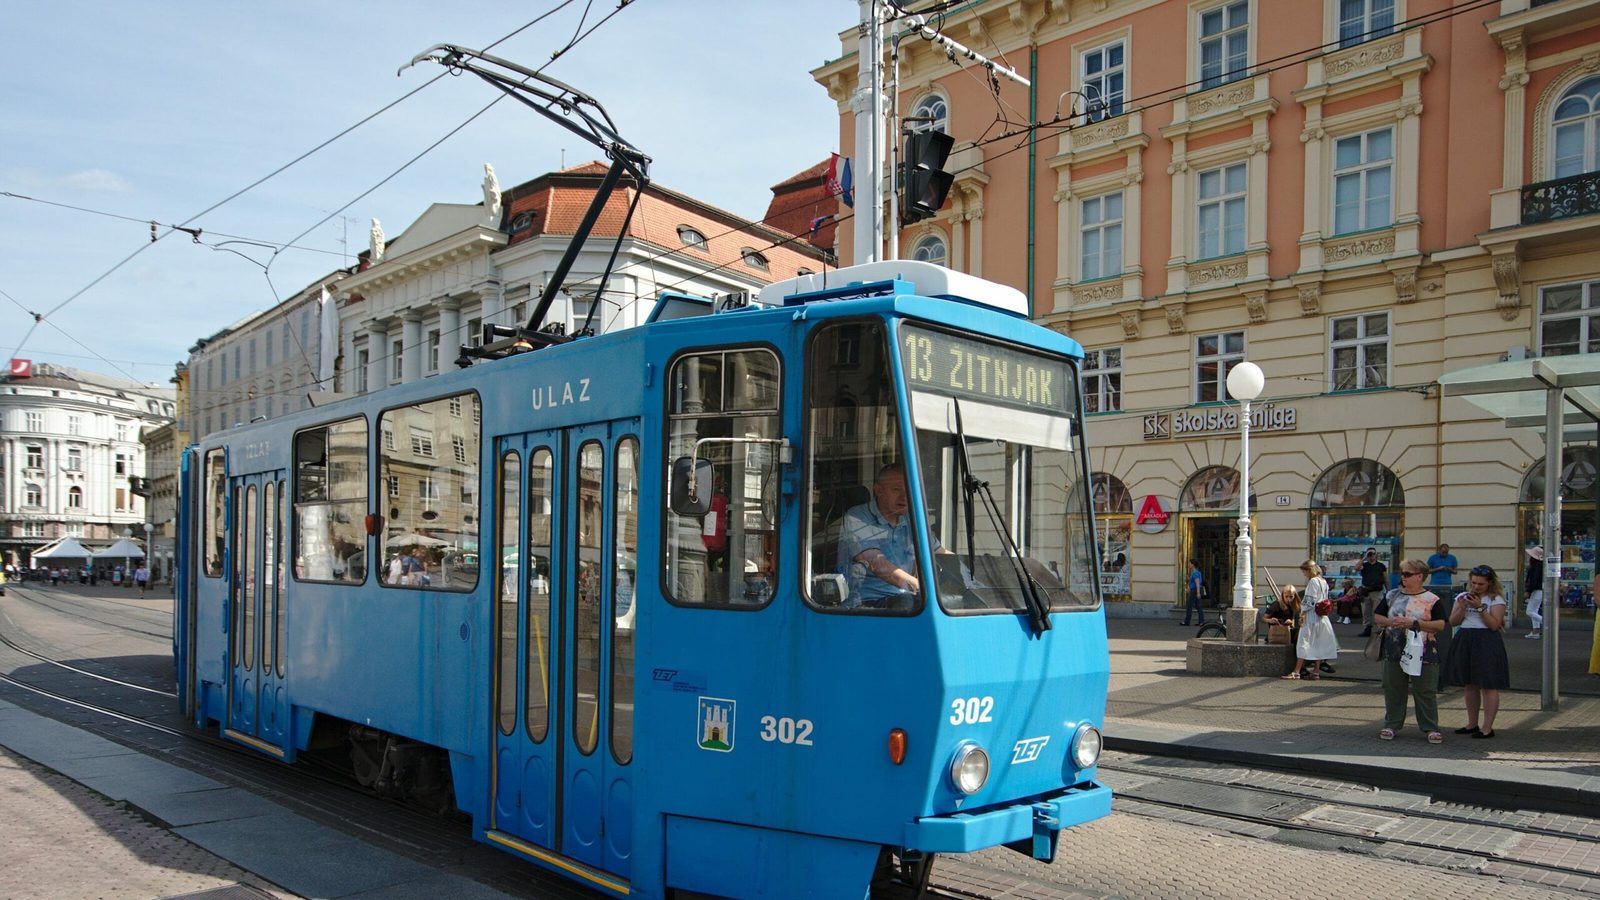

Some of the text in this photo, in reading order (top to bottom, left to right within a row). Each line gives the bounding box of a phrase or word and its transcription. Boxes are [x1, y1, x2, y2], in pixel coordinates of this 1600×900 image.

[905, 334, 933, 382] 13
[532, 378, 591, 410] ULAZ
[653, 668, 677, 682] ZET
[950, 695, 994, 726] 302
[760, 715, 813, 746] 302
[1011, 735, 1050, 765] ZET
